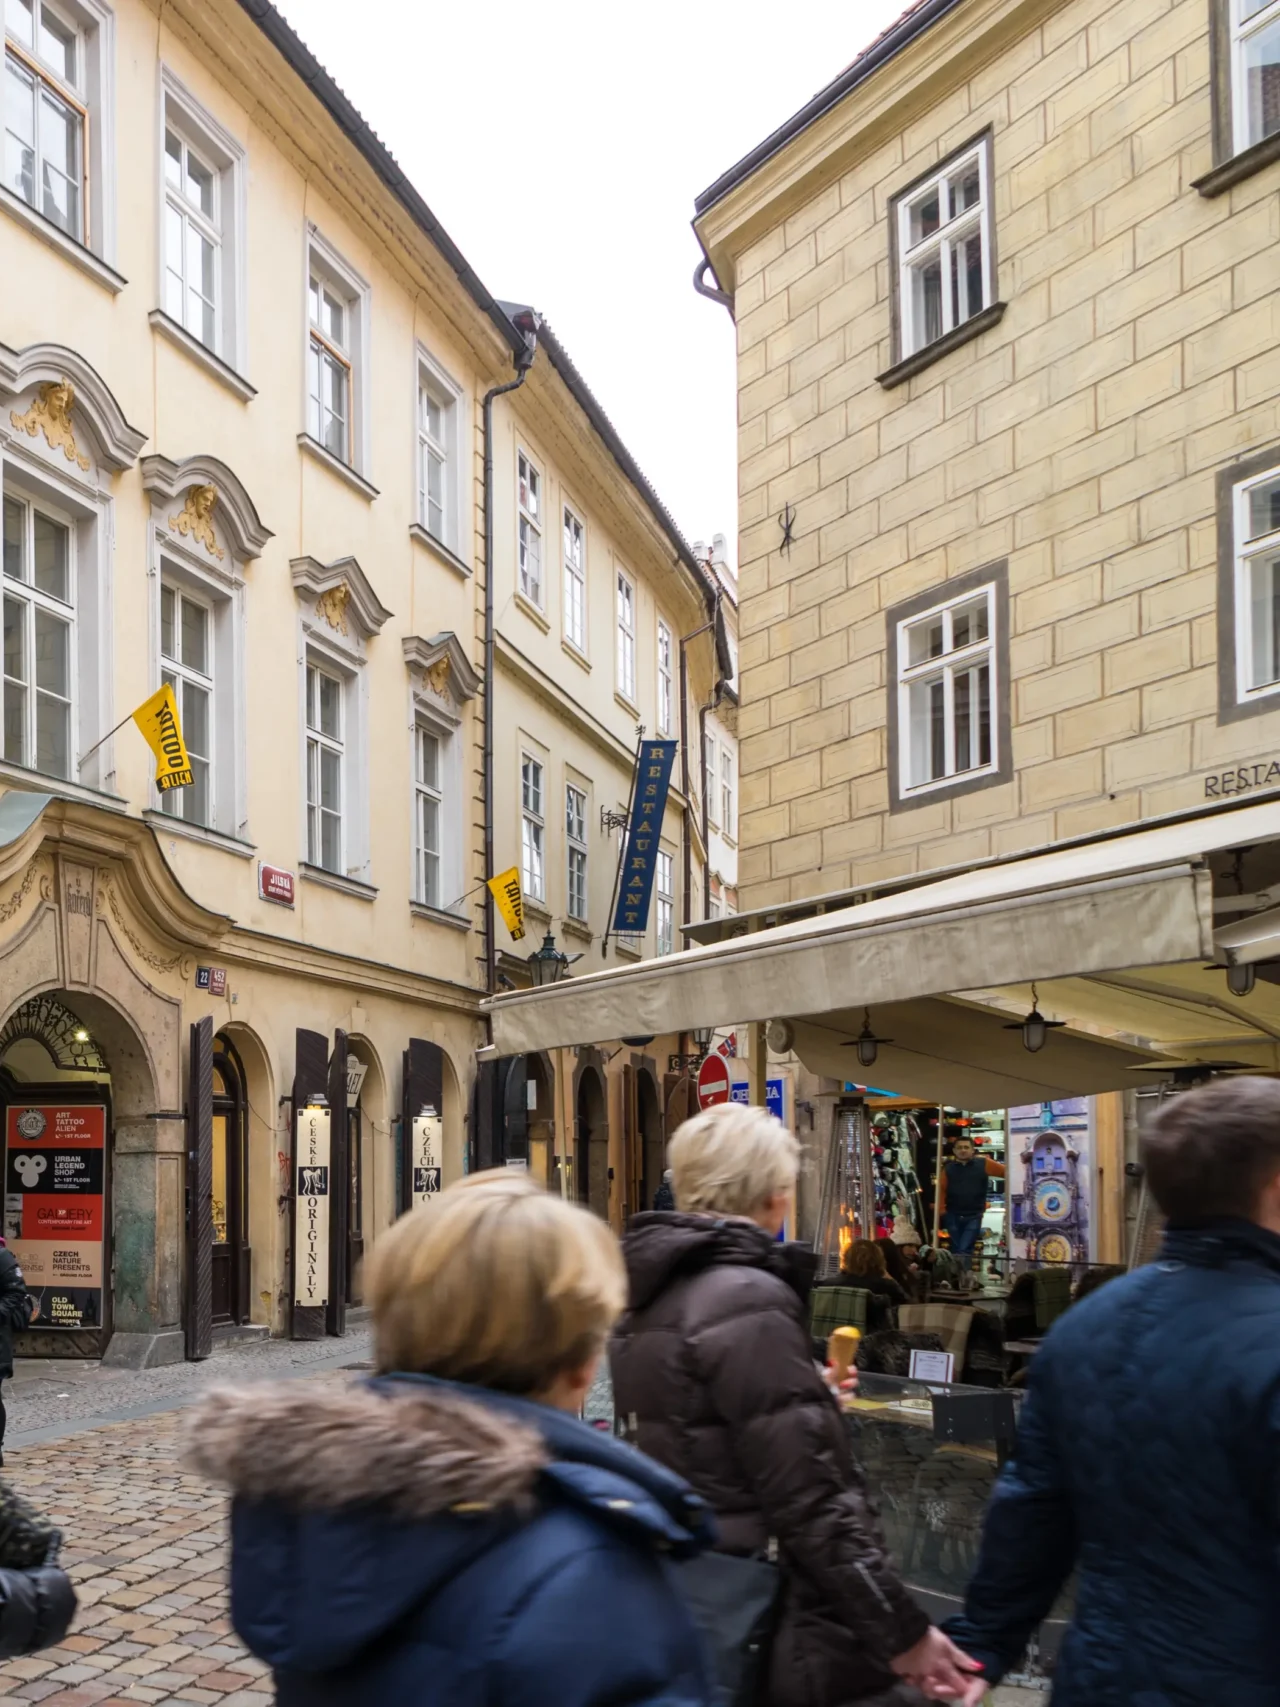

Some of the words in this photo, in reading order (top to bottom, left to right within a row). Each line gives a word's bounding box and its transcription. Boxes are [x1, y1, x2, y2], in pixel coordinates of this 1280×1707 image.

[155, 700, 184, 768] TATTOO
[161, 771, 192, 788] ALIEN
[625, 748, 664, 923] RESTAURANT
[200, 971, 208, 983] 22
[214, 970, 225, 983] 452
[309, 1117, 317, 1166] ČESKÉ
[420, 1127, 434, 1166] CZECH
[306, 1196, 318, 1299] ORIGINÁLY
